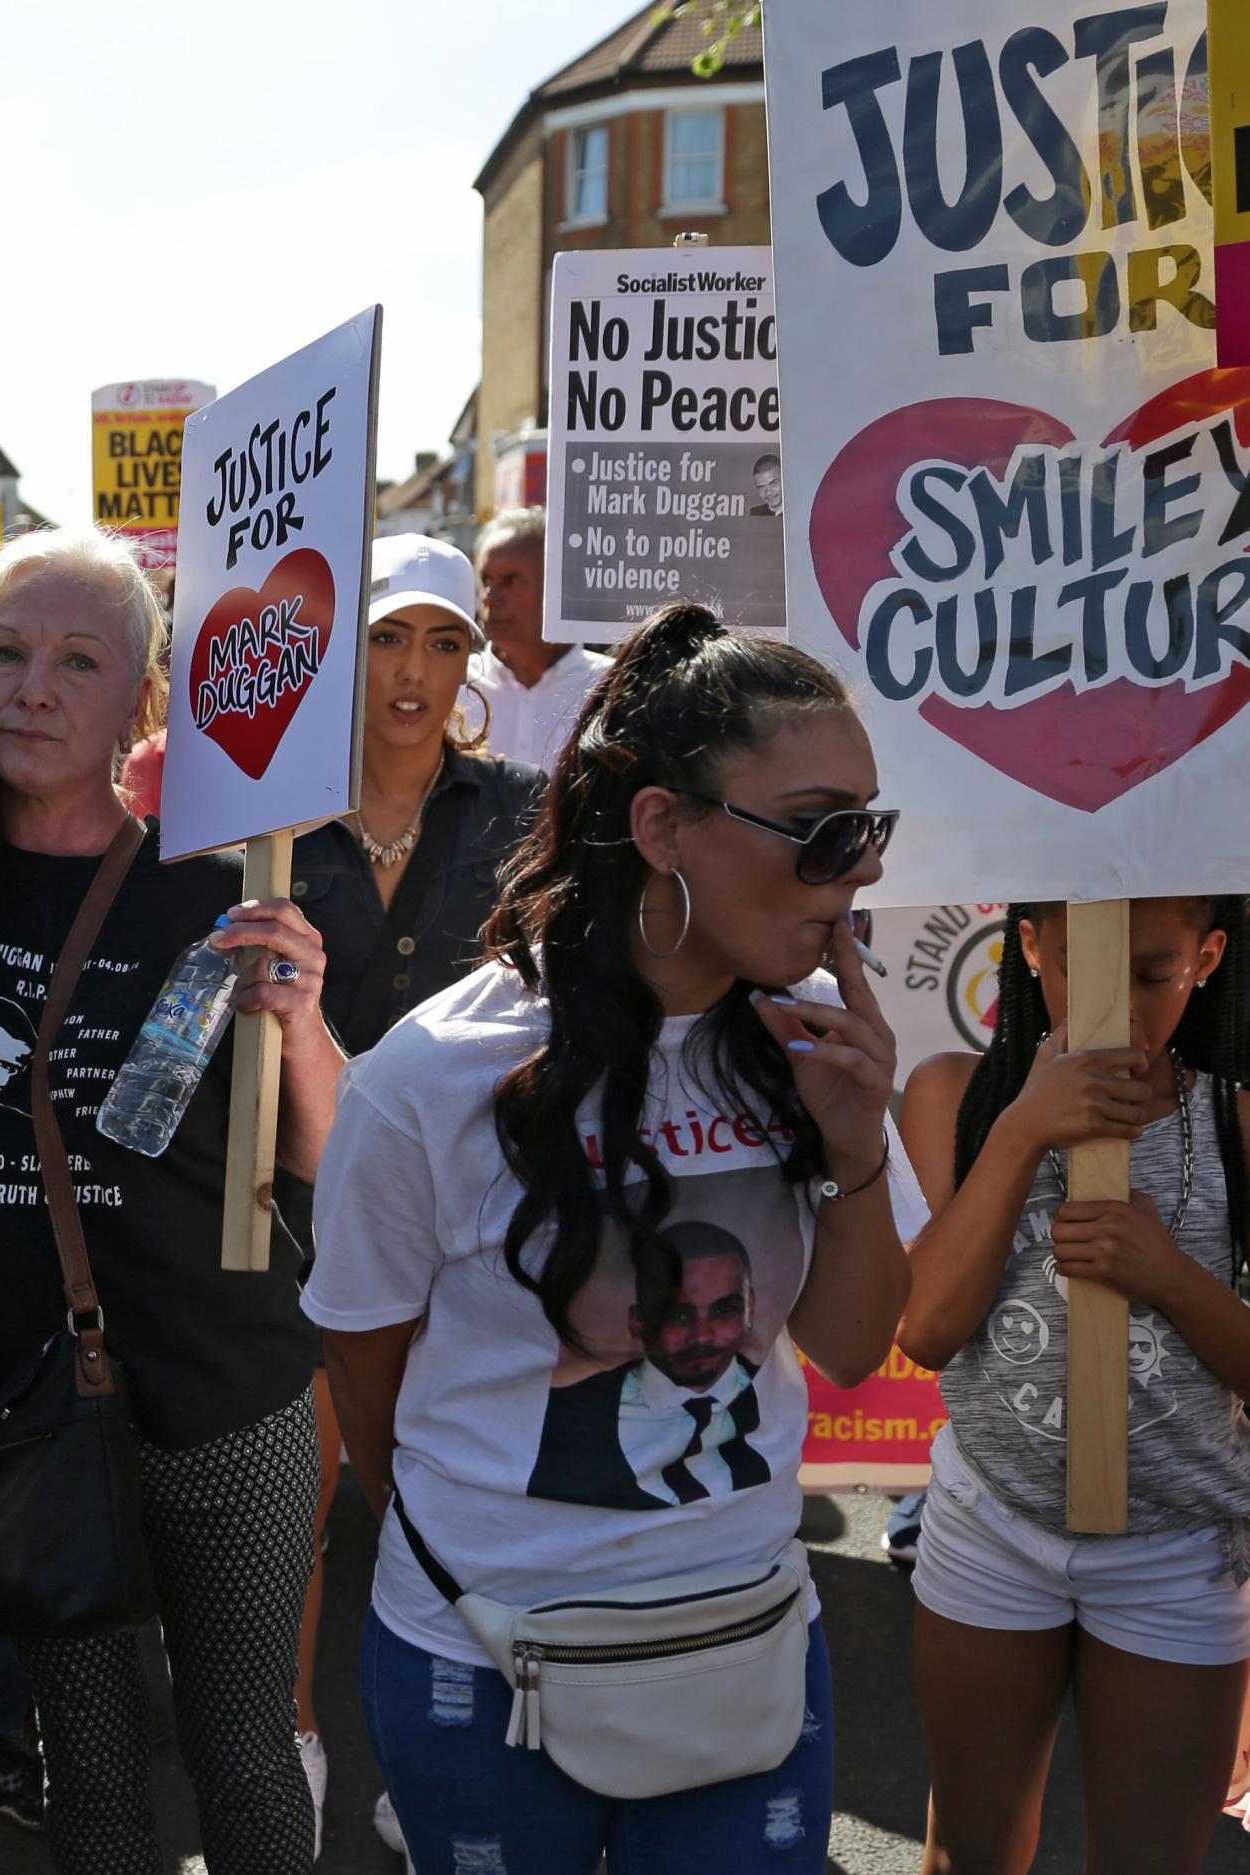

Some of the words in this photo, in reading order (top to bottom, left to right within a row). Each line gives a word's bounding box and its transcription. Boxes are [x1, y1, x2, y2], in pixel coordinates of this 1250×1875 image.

[816, 5, 1212, 267] JUSTI
[933, 244, 1216, 356] FOR
[569, 300, 630, 362] No
[644, 298, 777, 361] Justic
[567, 371, 627, 432] No
[641, 370, 781, 432] Peace
[110, 430, 183, 458] BLAC
[207, 387, 337, 527] JUSTICE
[118, 461, 181, 488] LIVE
[589, 451, 672, 482] Justice
[679, 452, 716, 482] for
[98, 492, 181, 519] MATT
[588, 485, 646, 515] Mark
[655, 486, 745, 521] Duggan
[901, 419, 1250, 583] SMILEY
[226, 492, 305, 570] FOR
[586, 527, 616, 556] No
[625, 527, 650, 557] to
[659, 528, 731, 562] police
[584, 560, 681, 590] violence
[209, 598, 309, 680] MARK
[866, 557, 1250, 701] CULTUR
[196, 627, 319, 730] DUGGAN
[905, 905, 971, 992] STAND
[16, 979, 48, 1000] R.I.P.
[78, 1028, 120, 1041] FATHER
[49, 1048, 77, 1062] OTHER
[67, 1067, 116, 1080] PARTNER
[76, 1106, 98, 1118] FRIE
